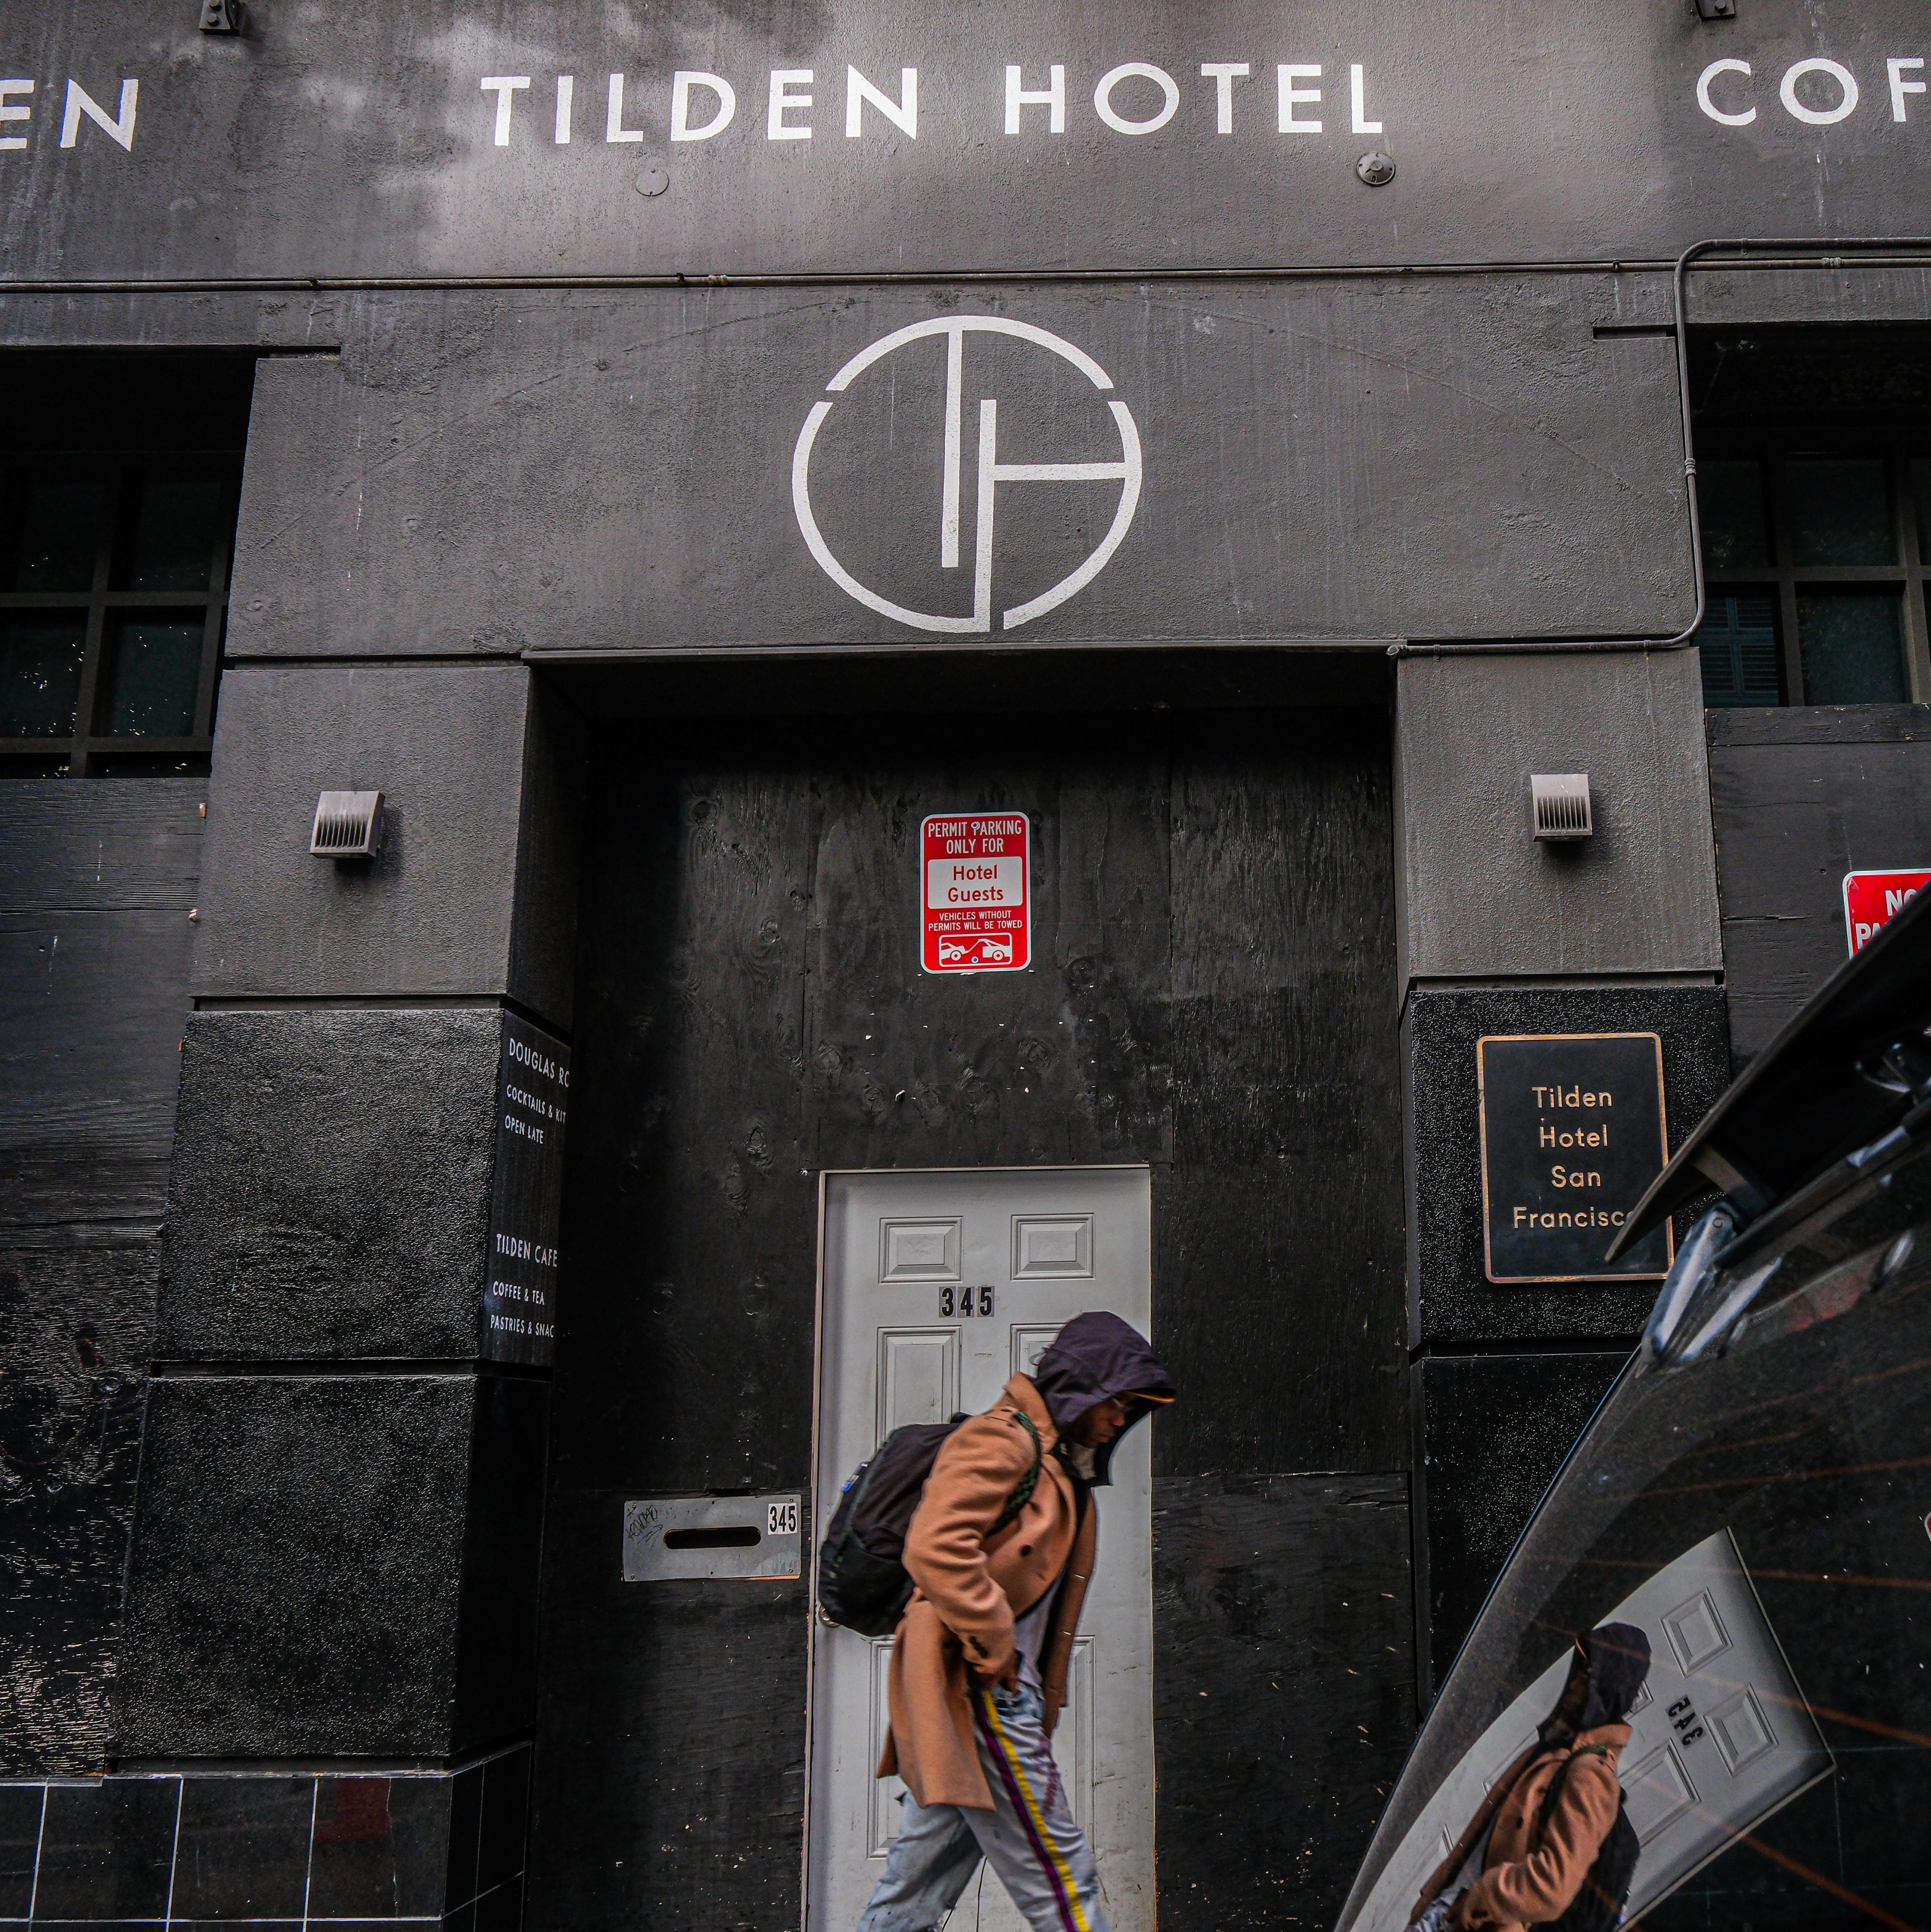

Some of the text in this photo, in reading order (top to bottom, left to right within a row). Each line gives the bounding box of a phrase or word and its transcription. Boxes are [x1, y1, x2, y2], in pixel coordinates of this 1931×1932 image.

[481, 62, 1382, 146] TILDEN HOTEL
[1697, 58, 1926, 126] COF
[928, 820, 1021, 837] PERMIT PARKING
[946, 838, 1004, 854] ONLY FOR
[953, 864, 998, 880] Hotel
[948, 886, 1004, 902] Guests
[928, 920, 1022, 931] PERMITS WILL BE TOWED
[939, 910, 1012, 920] VEHICLES WITHOUT
[509, 1038, 555, 1079] DOUGLAS
[506, 1084, 546, 1115] COCKTAILS
[548, 1105, 553, 1118] &
[1532, 1085, 1612, 1108] Tilden
[505, 1115, 544, 1144] OPEN LATE
[1539, 1124, 1608, 1148] Hotel
[1551, 1165, 1602, 1188] San
[496, 1233, 558, 1267] TILDEN CAFE
[493, 1281, 545, 1305] COFFEE & TEA
[941, 1287, 992, 1317] 345
[490, 1314, 555, 1338] PASTRIES & SNAC
[769, 1505, 797, 1533] 345
